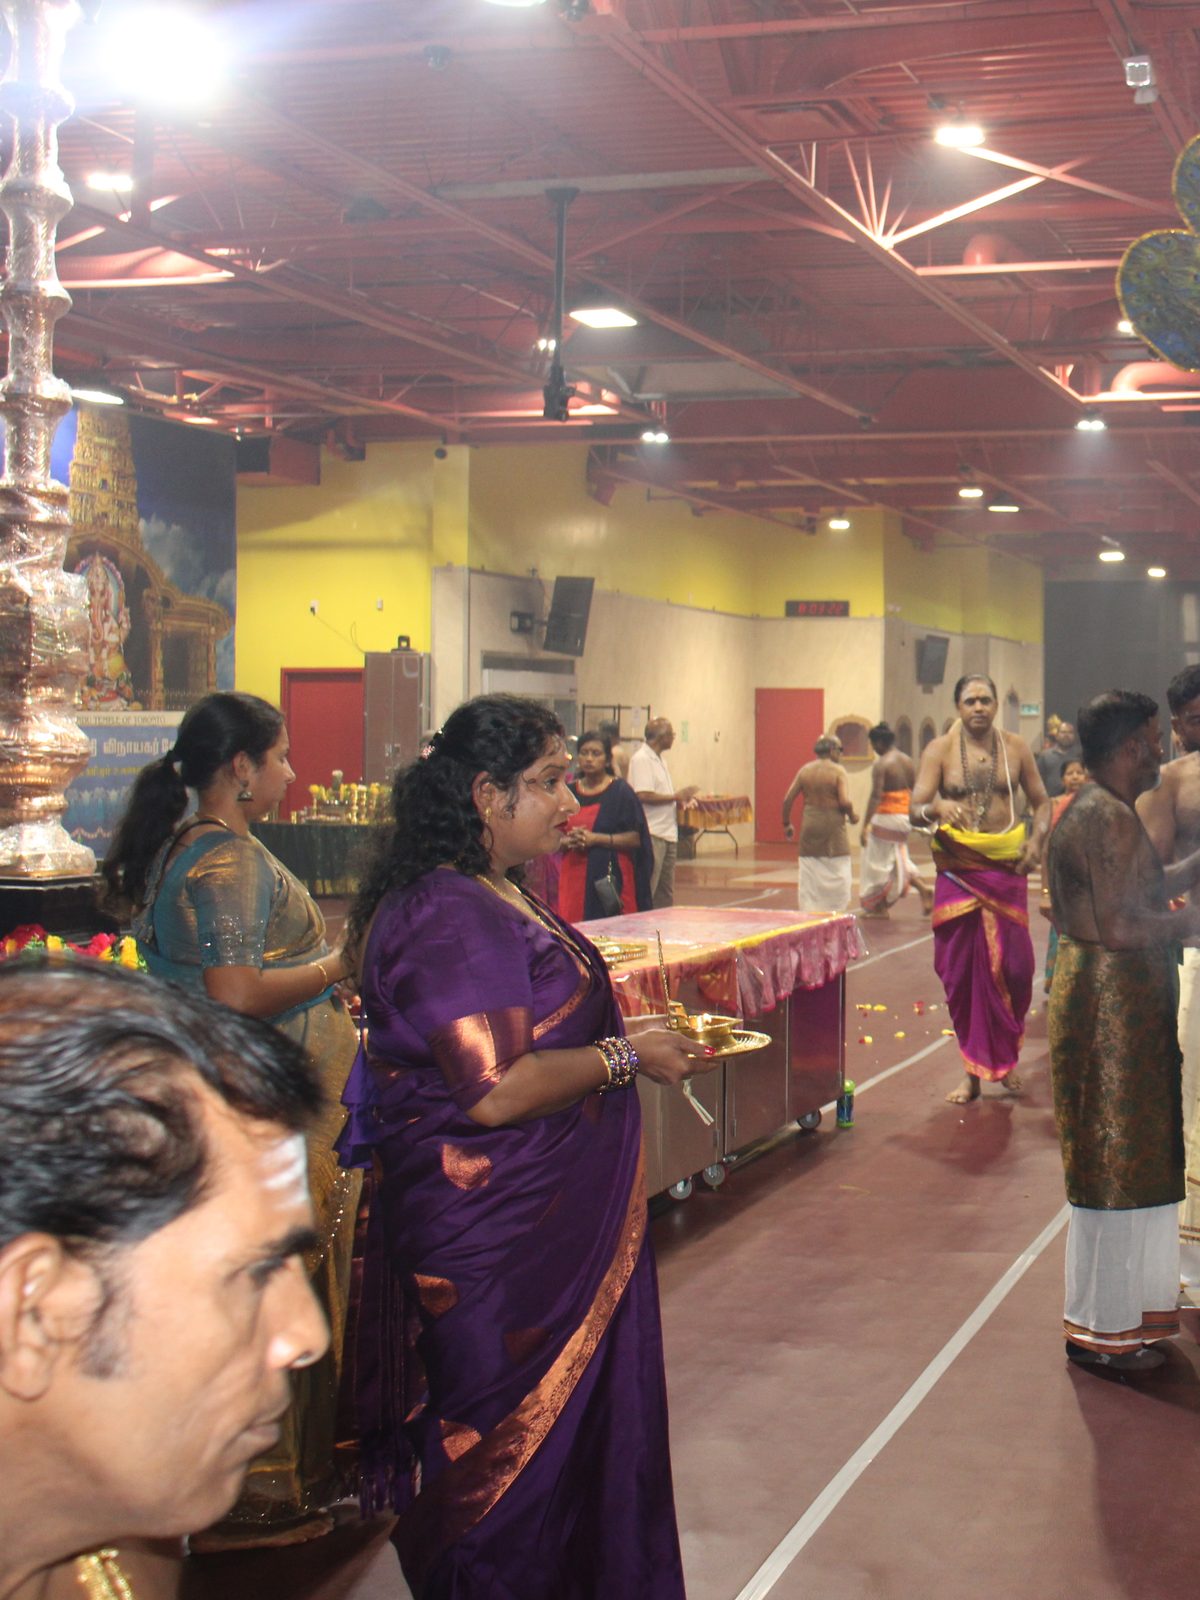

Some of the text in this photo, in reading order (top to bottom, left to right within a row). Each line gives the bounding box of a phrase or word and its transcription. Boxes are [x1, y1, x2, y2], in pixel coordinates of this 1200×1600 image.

[94, 715, 119, 725] TEMPLE
[122, 715, 131, 725] OF
[134, 715, 166, 725] TORONTO
[103, 737, 159, 757] விநாயகர்
